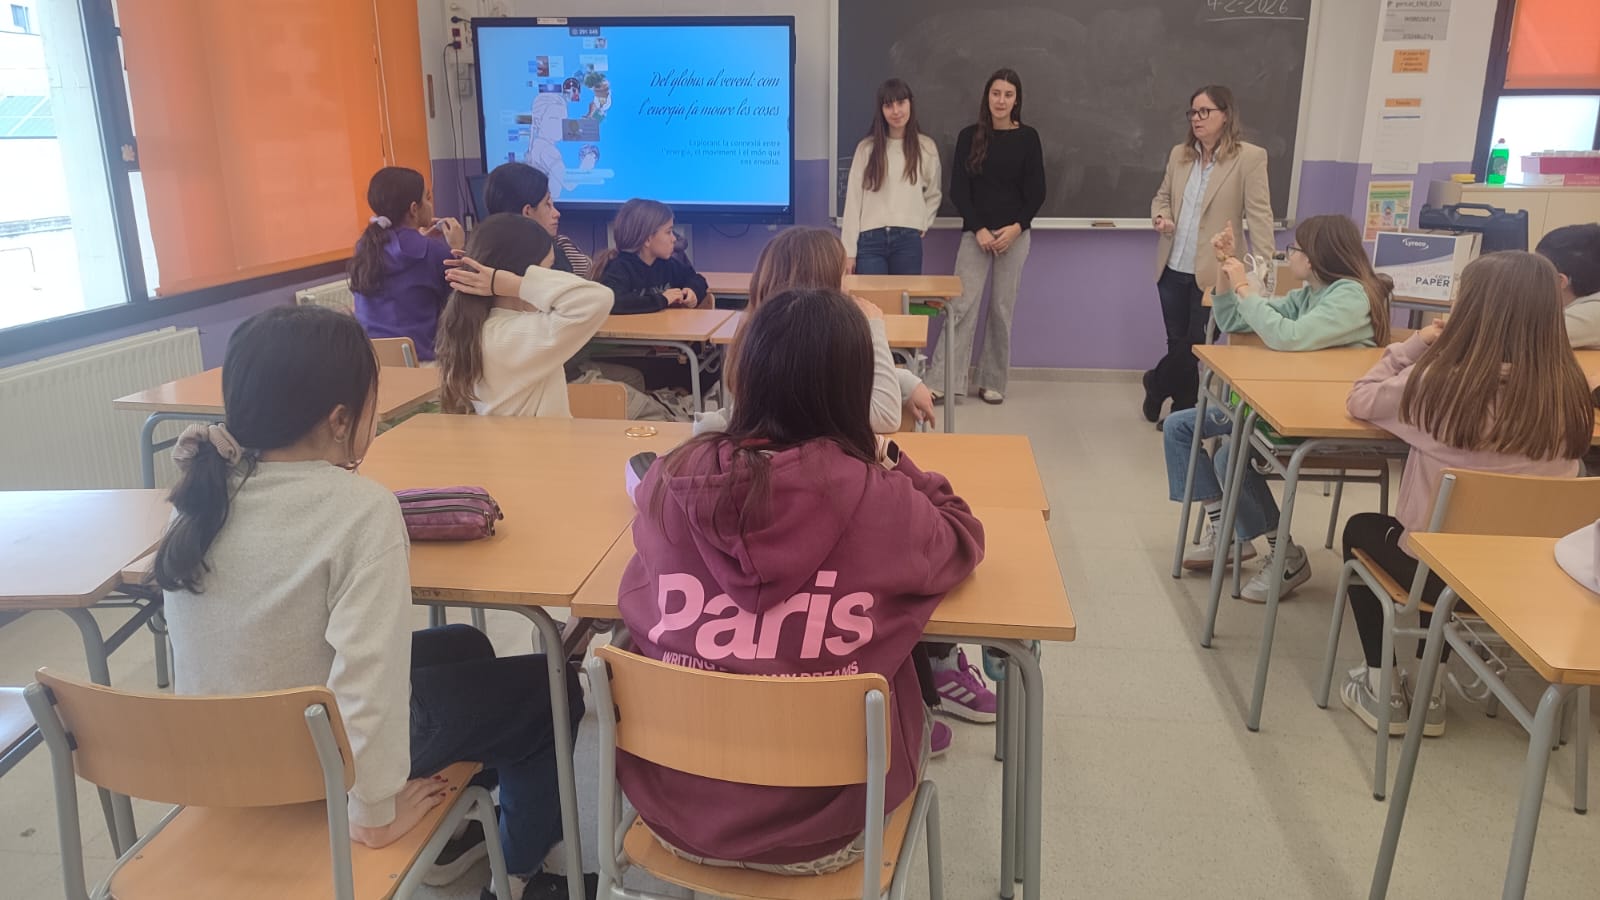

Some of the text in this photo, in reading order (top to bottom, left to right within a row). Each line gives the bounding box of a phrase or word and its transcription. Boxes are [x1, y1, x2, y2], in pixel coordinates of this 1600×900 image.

[650, 69, 675, 87] Del
[667, 68, 704, 97] globus
[706, 67, 725, 87] al
[757, 77, 780, 88] com
[701, 105, 735, 116] moure
[736, 97, 750, 116] les
[753, 104, 780, 116] coses
[1415, 276, 1450, 287] PAPER
[648, 570, 875, 660] Paris
